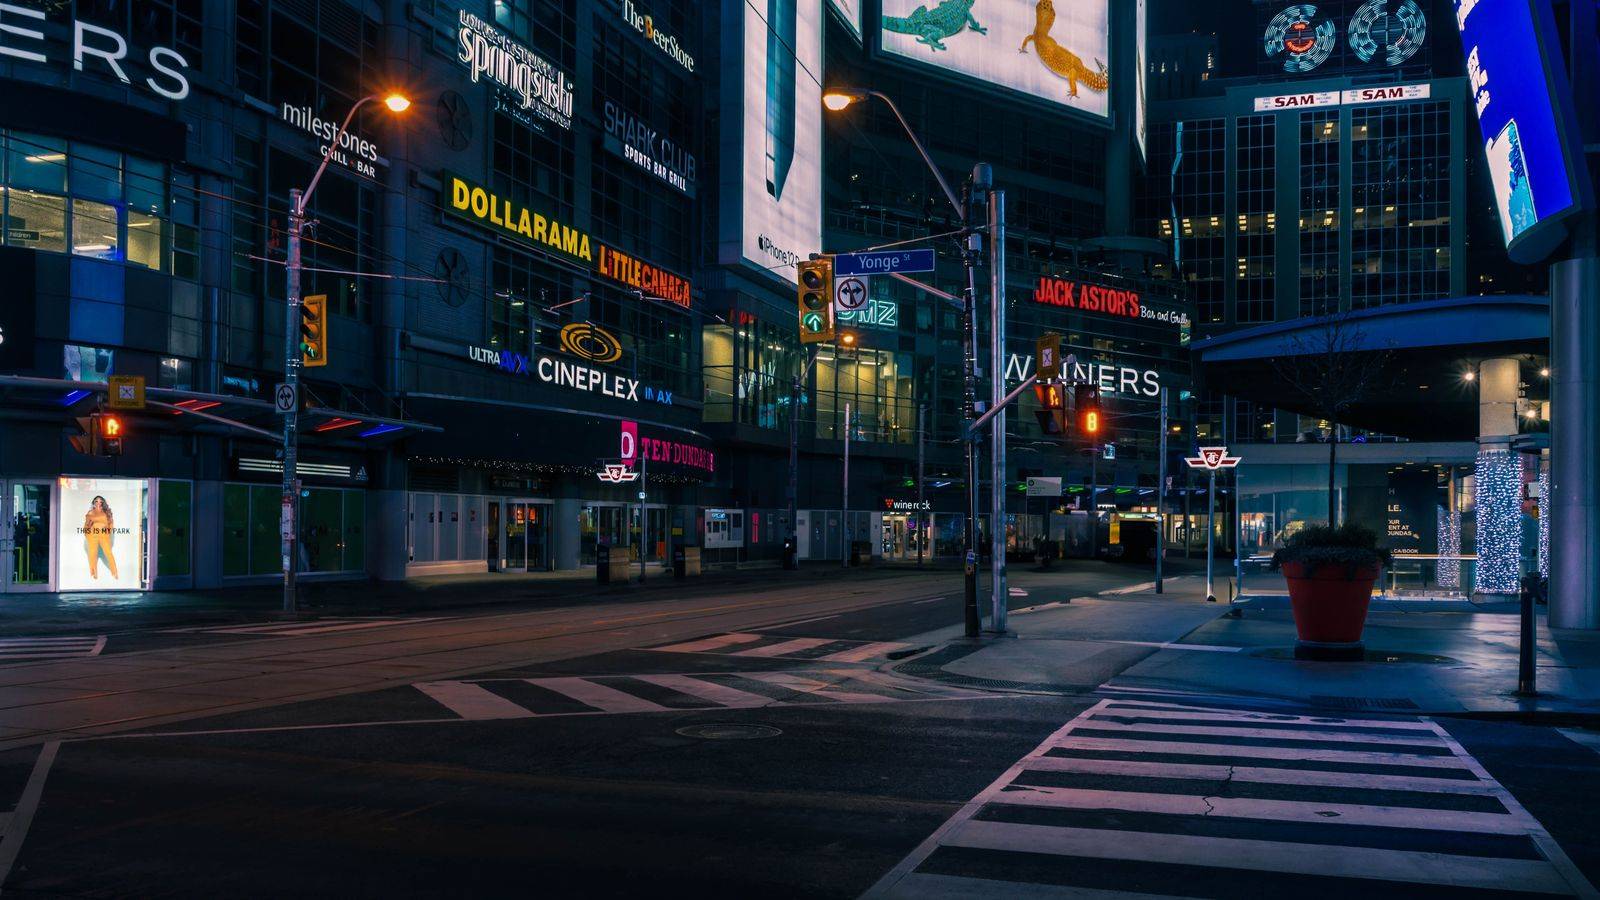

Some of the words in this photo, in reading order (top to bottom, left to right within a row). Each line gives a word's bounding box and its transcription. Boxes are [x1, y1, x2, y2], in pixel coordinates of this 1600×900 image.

[1275, 95, 1315, 108] SAM
[1362, 87, 1403, 100] SAM
[283, 102, 378, 162] milestones
[604, 101, 656, 160] SHARK
[661, 138, 697, 181] CLUB
[357, 160, 376, 178] BAR
[624, 143, 652, 171] SPORTS
[653, 161, 668, 181] BAR
[669, 170, 687, 191] GRILL
[453, 177, 593, 262] DOLLARAMA
[858, 255, 900, 271] Yonge
[903, 253, 911, 261] St
[1034, 277, 1076, 308] JACK
[1079, 284, 1141, 318] ASTOR'S
[538, 357, 640, 402] CINEPLEX
[641, 436, 672, 463] TEN
[893, 499, 912, 510] wine
